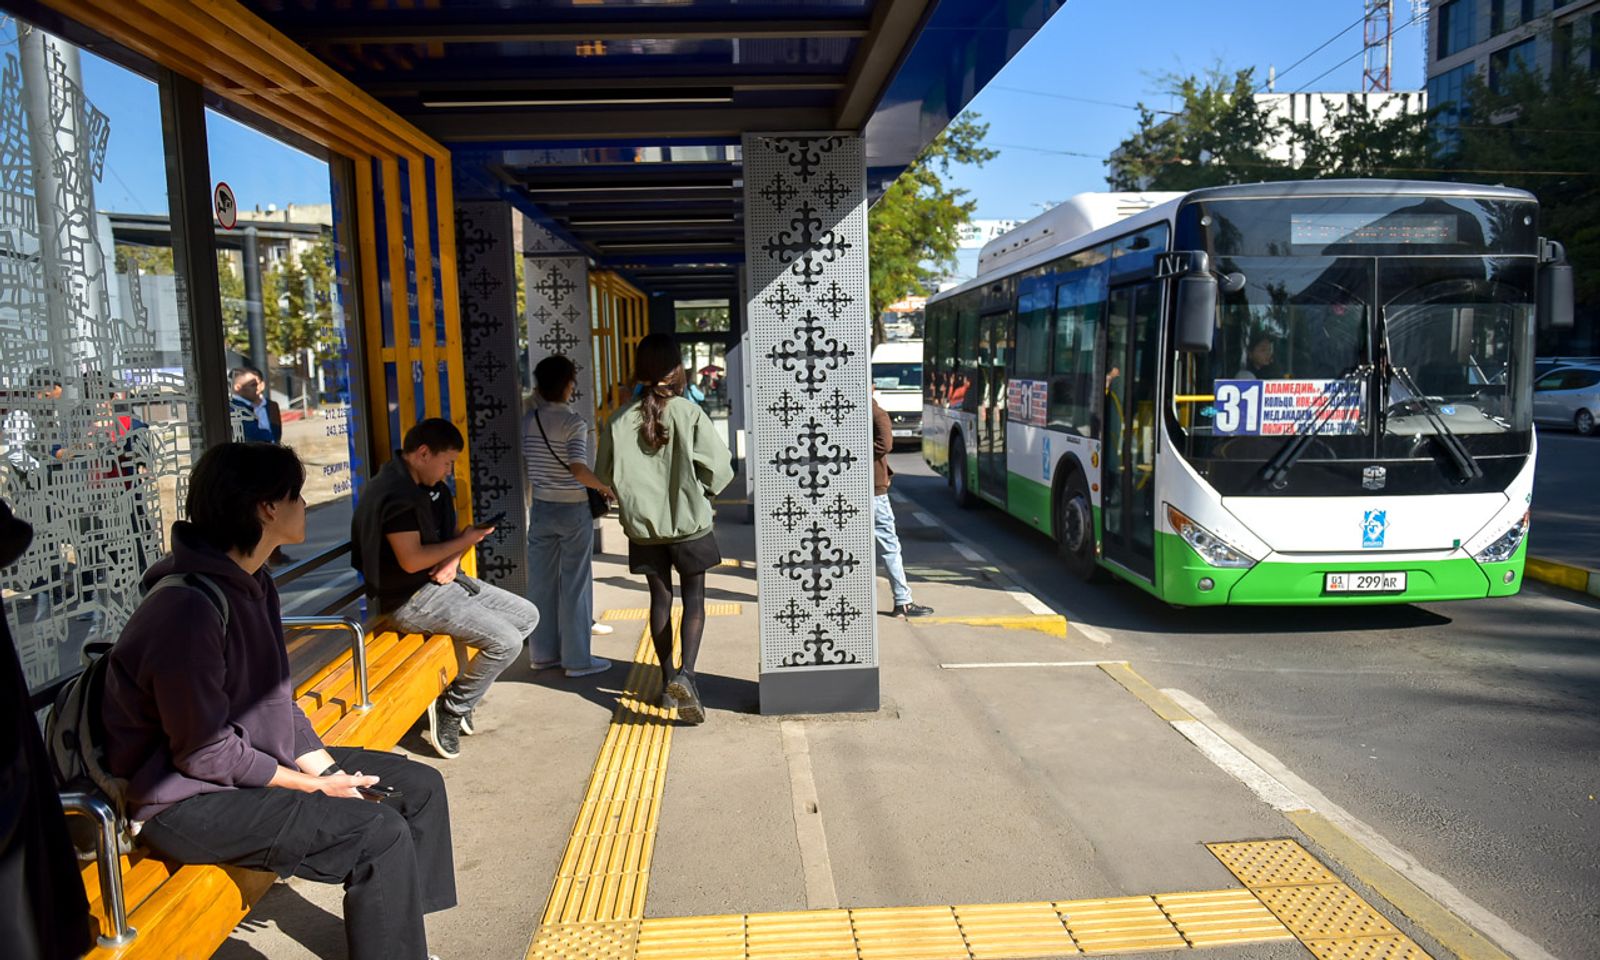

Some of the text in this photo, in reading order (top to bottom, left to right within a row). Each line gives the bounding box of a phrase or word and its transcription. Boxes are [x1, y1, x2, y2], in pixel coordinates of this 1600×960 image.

[1216, 384, 1259, 432] 31
[1357, 576, 1381, 588] 299
[1383, 577, 1397, 588] AR
